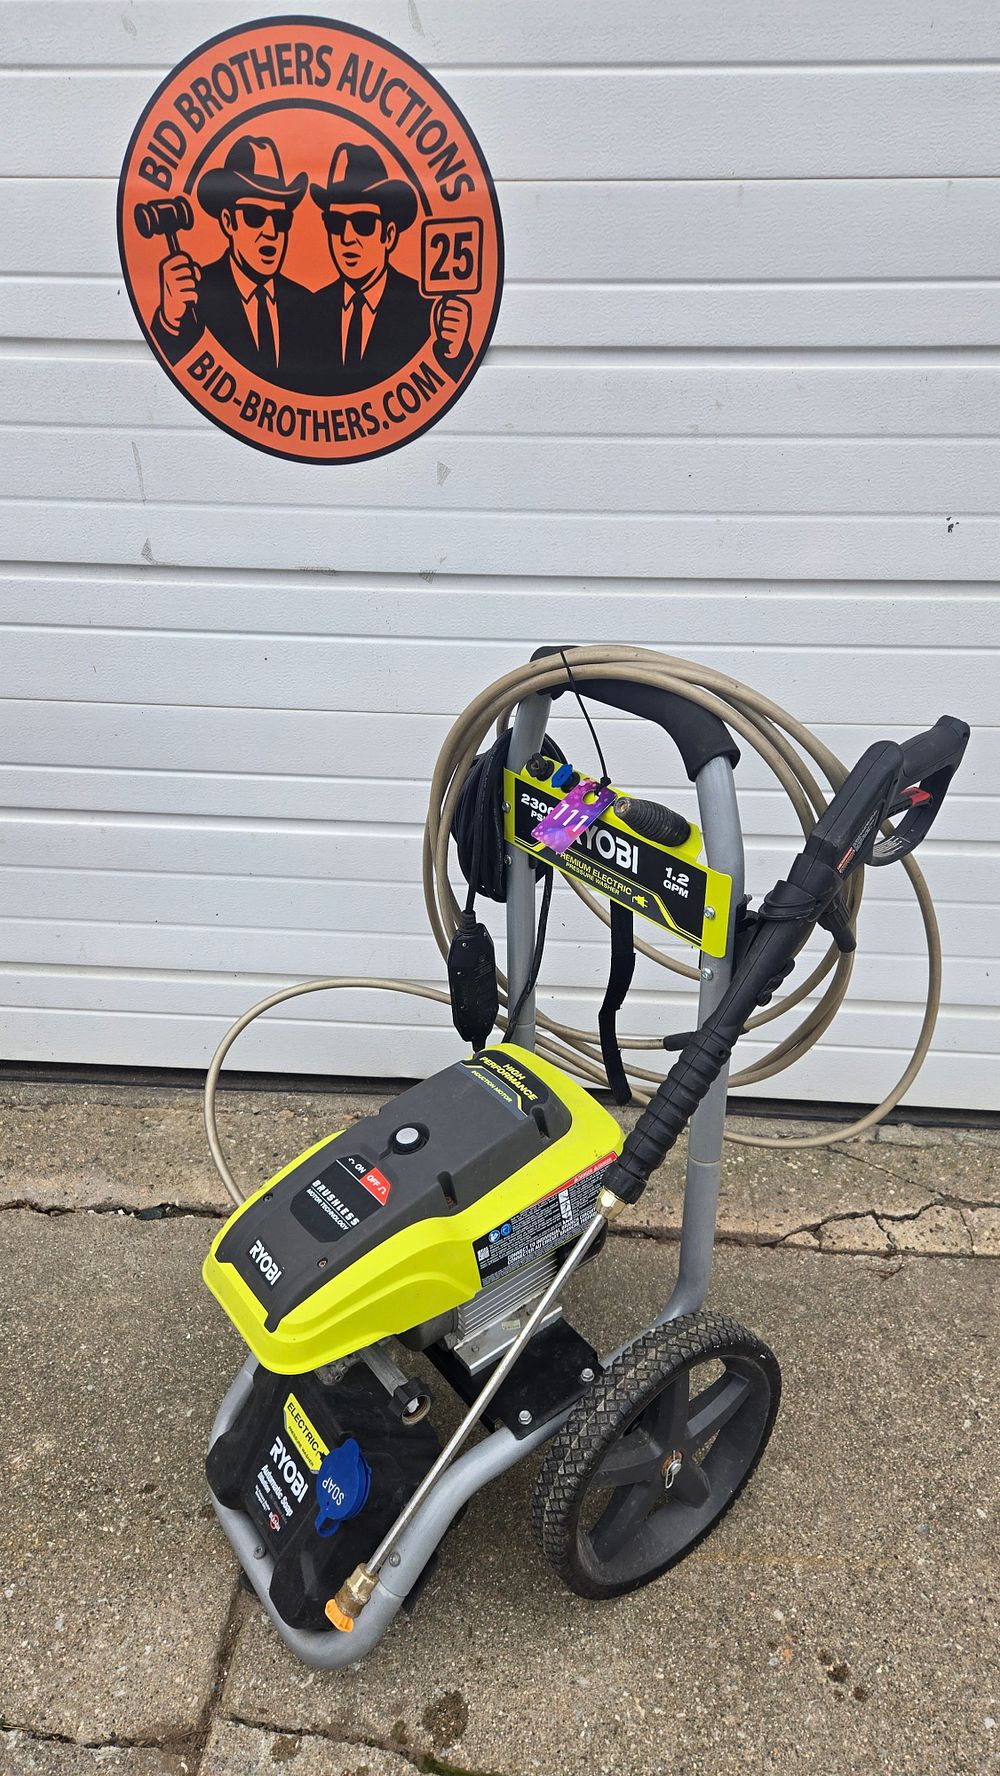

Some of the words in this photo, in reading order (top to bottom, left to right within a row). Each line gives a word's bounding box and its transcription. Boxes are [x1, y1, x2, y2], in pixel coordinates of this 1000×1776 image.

[138, 119, 187, 192] BID
[174, 42, 333, 134] BROTHERS
[336, 53, 475, 202] AUCTIONS
[429, 232, 474, 282] 25
[186, 350, 446, 443] BID-BROTHERS.COM
[553, 803, 589, 833] 111
[575, 825, 639, 875] YOBI
[566, 862, 594, 883] PRESSURE
[595, 878, 620, 895] WASHER
[593, 868, 632, 895] ELECTRIC
[663, 880, 689, 899] GPM
[665, 866, 690, 887] 1.2
[480, 1056, 538, 1101] PERFORMANCE
[502, 1063, 526, 1080] HIGH
[494, 1087, 512, 1103] MOTOR
[355, 1163, 366, 1173] ON
[366, 1175, 381, 1186] OFF
[306, 1188, 322, 1205] MOTOR
[320, 1201, 349, 1231] TECHNOLOGY
[312, 1180, 360, 1226] BRUSHLESS
[249, 1240, 282, 1286] RYOBI
[287, 1402, 319, 1451] ELECTRIC
[261, 1464, 284, 1500] Automatic
[280, 1495, 294, 1517] Soap
[269, 1436, 309, 1503] RYOBI
[322, 1477, 345, 1506] SOAP
